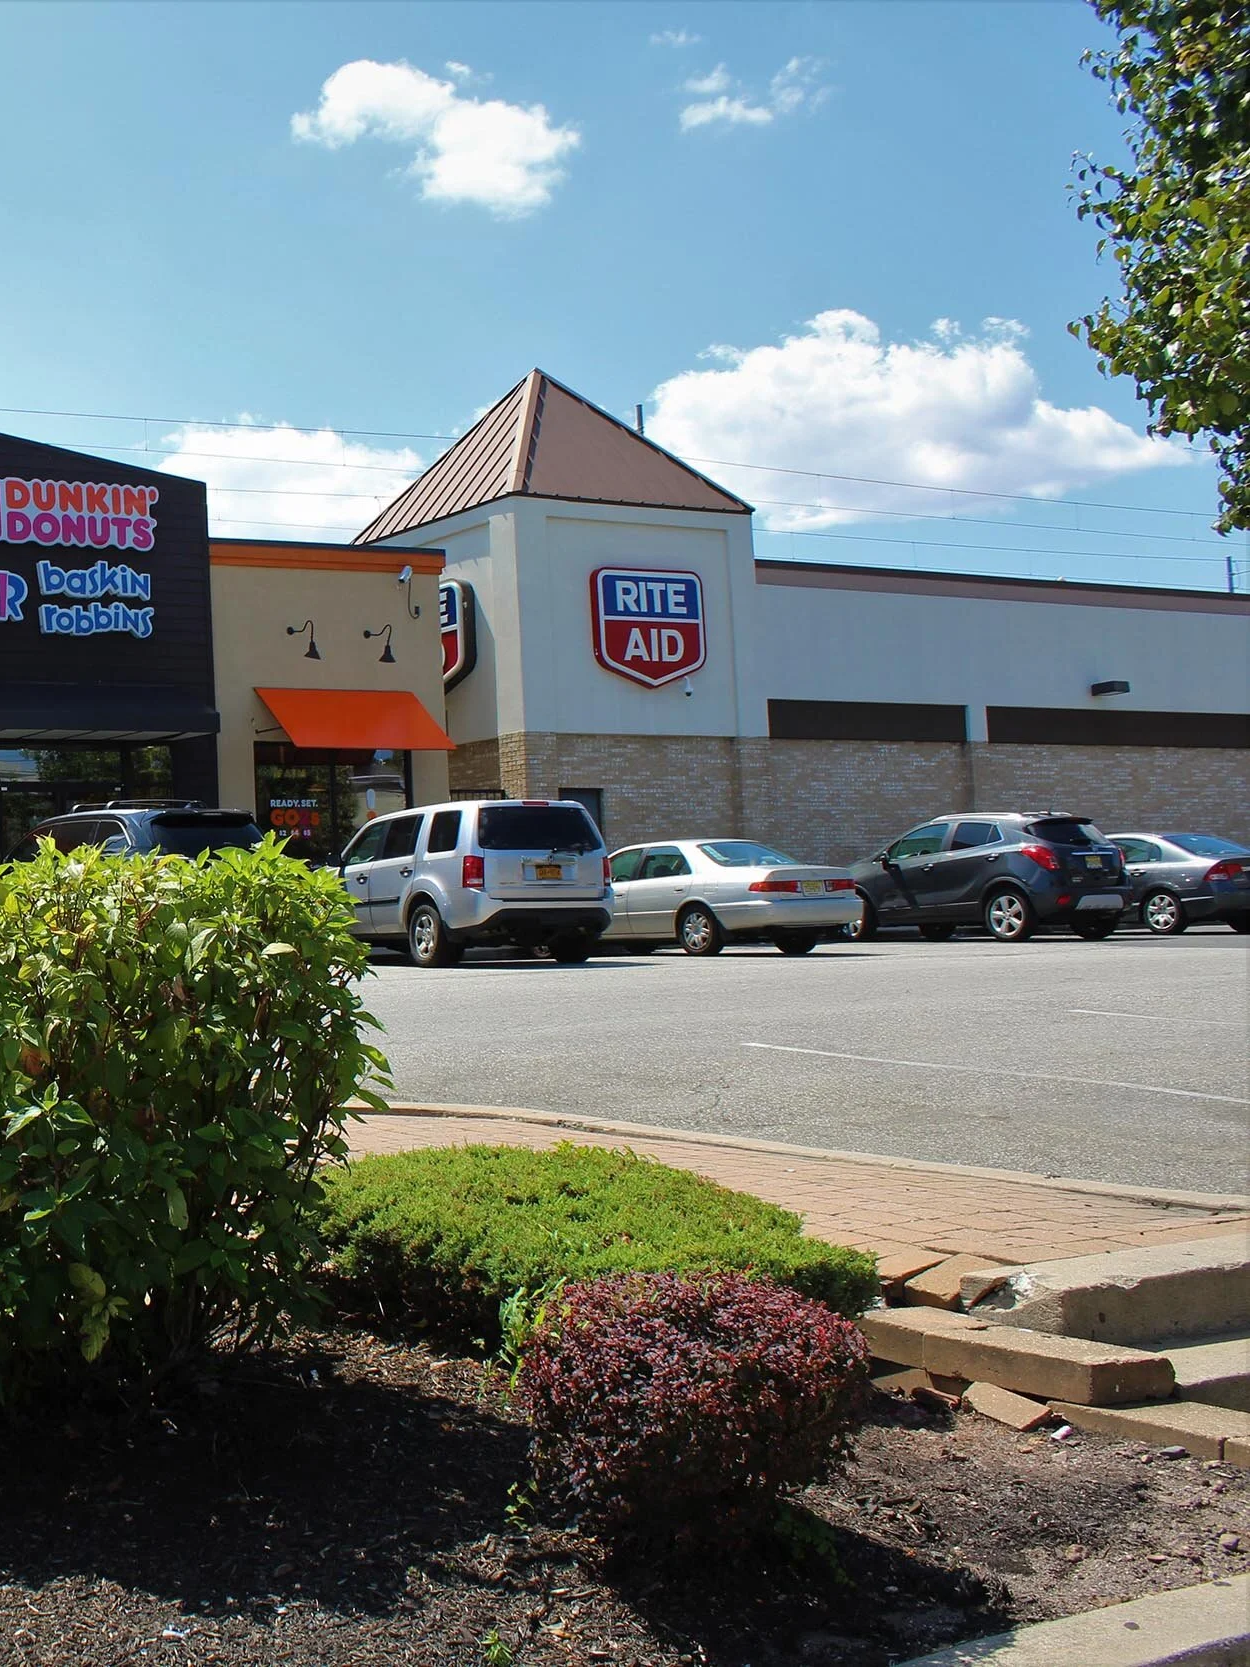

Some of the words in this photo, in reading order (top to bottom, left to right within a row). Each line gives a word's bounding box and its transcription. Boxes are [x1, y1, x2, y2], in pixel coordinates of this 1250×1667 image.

[6, 480, 156, 516] DUNKIN'
[614, 580, 688, 614] RITE
[623, 627, 685, 663] AID
